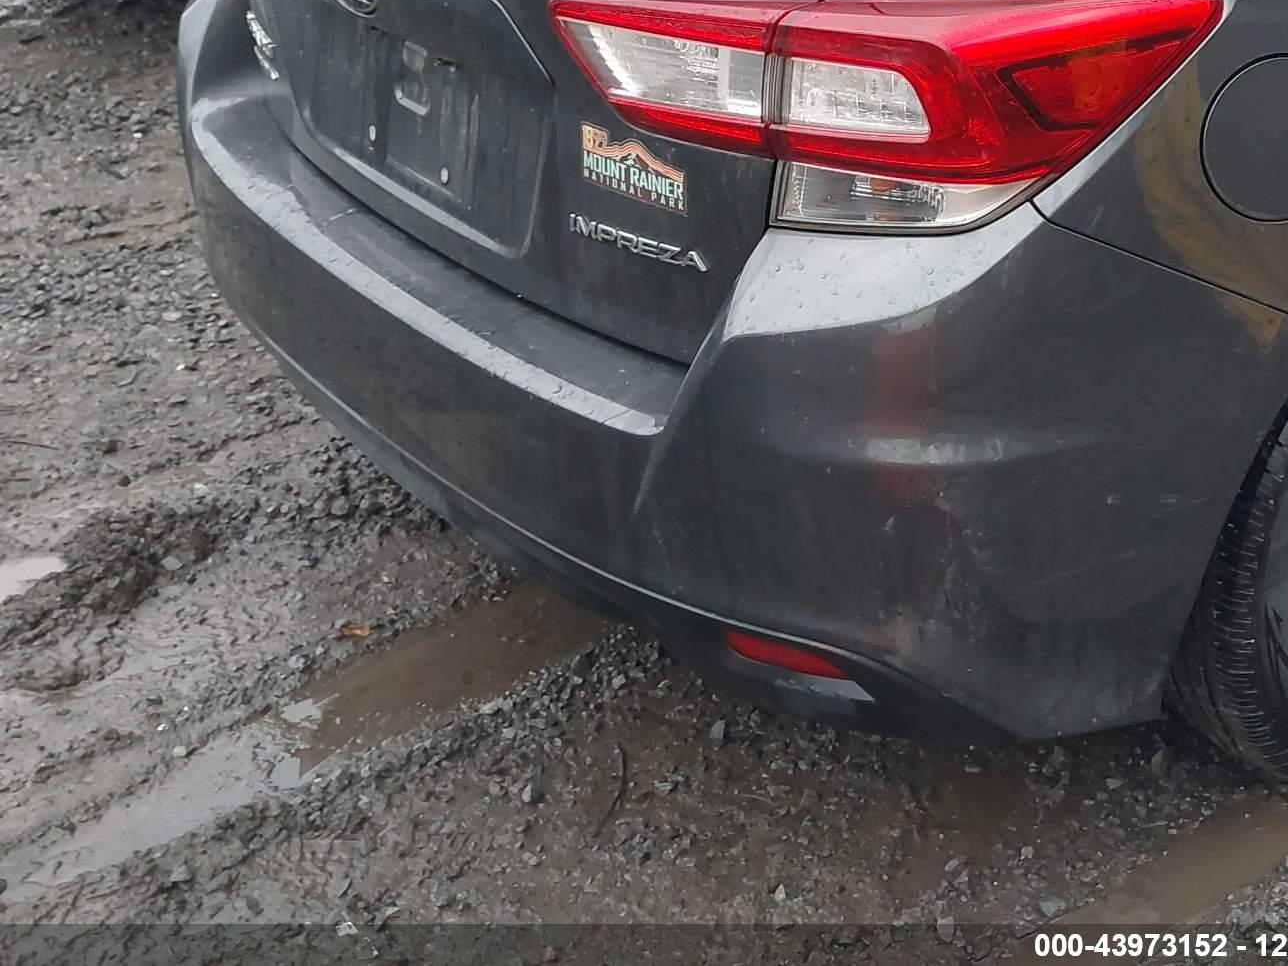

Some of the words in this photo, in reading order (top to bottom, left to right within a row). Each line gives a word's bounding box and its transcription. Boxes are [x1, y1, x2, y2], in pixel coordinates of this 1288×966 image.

[583, 149, 628, 181] MOUNT
[629, 166, 684, 201] RAINIER
[583, 167, 643, 198] NATIONAL
[650, 191, 685, 211] PARK
[568, 212, 710, 273] IMPREZA
